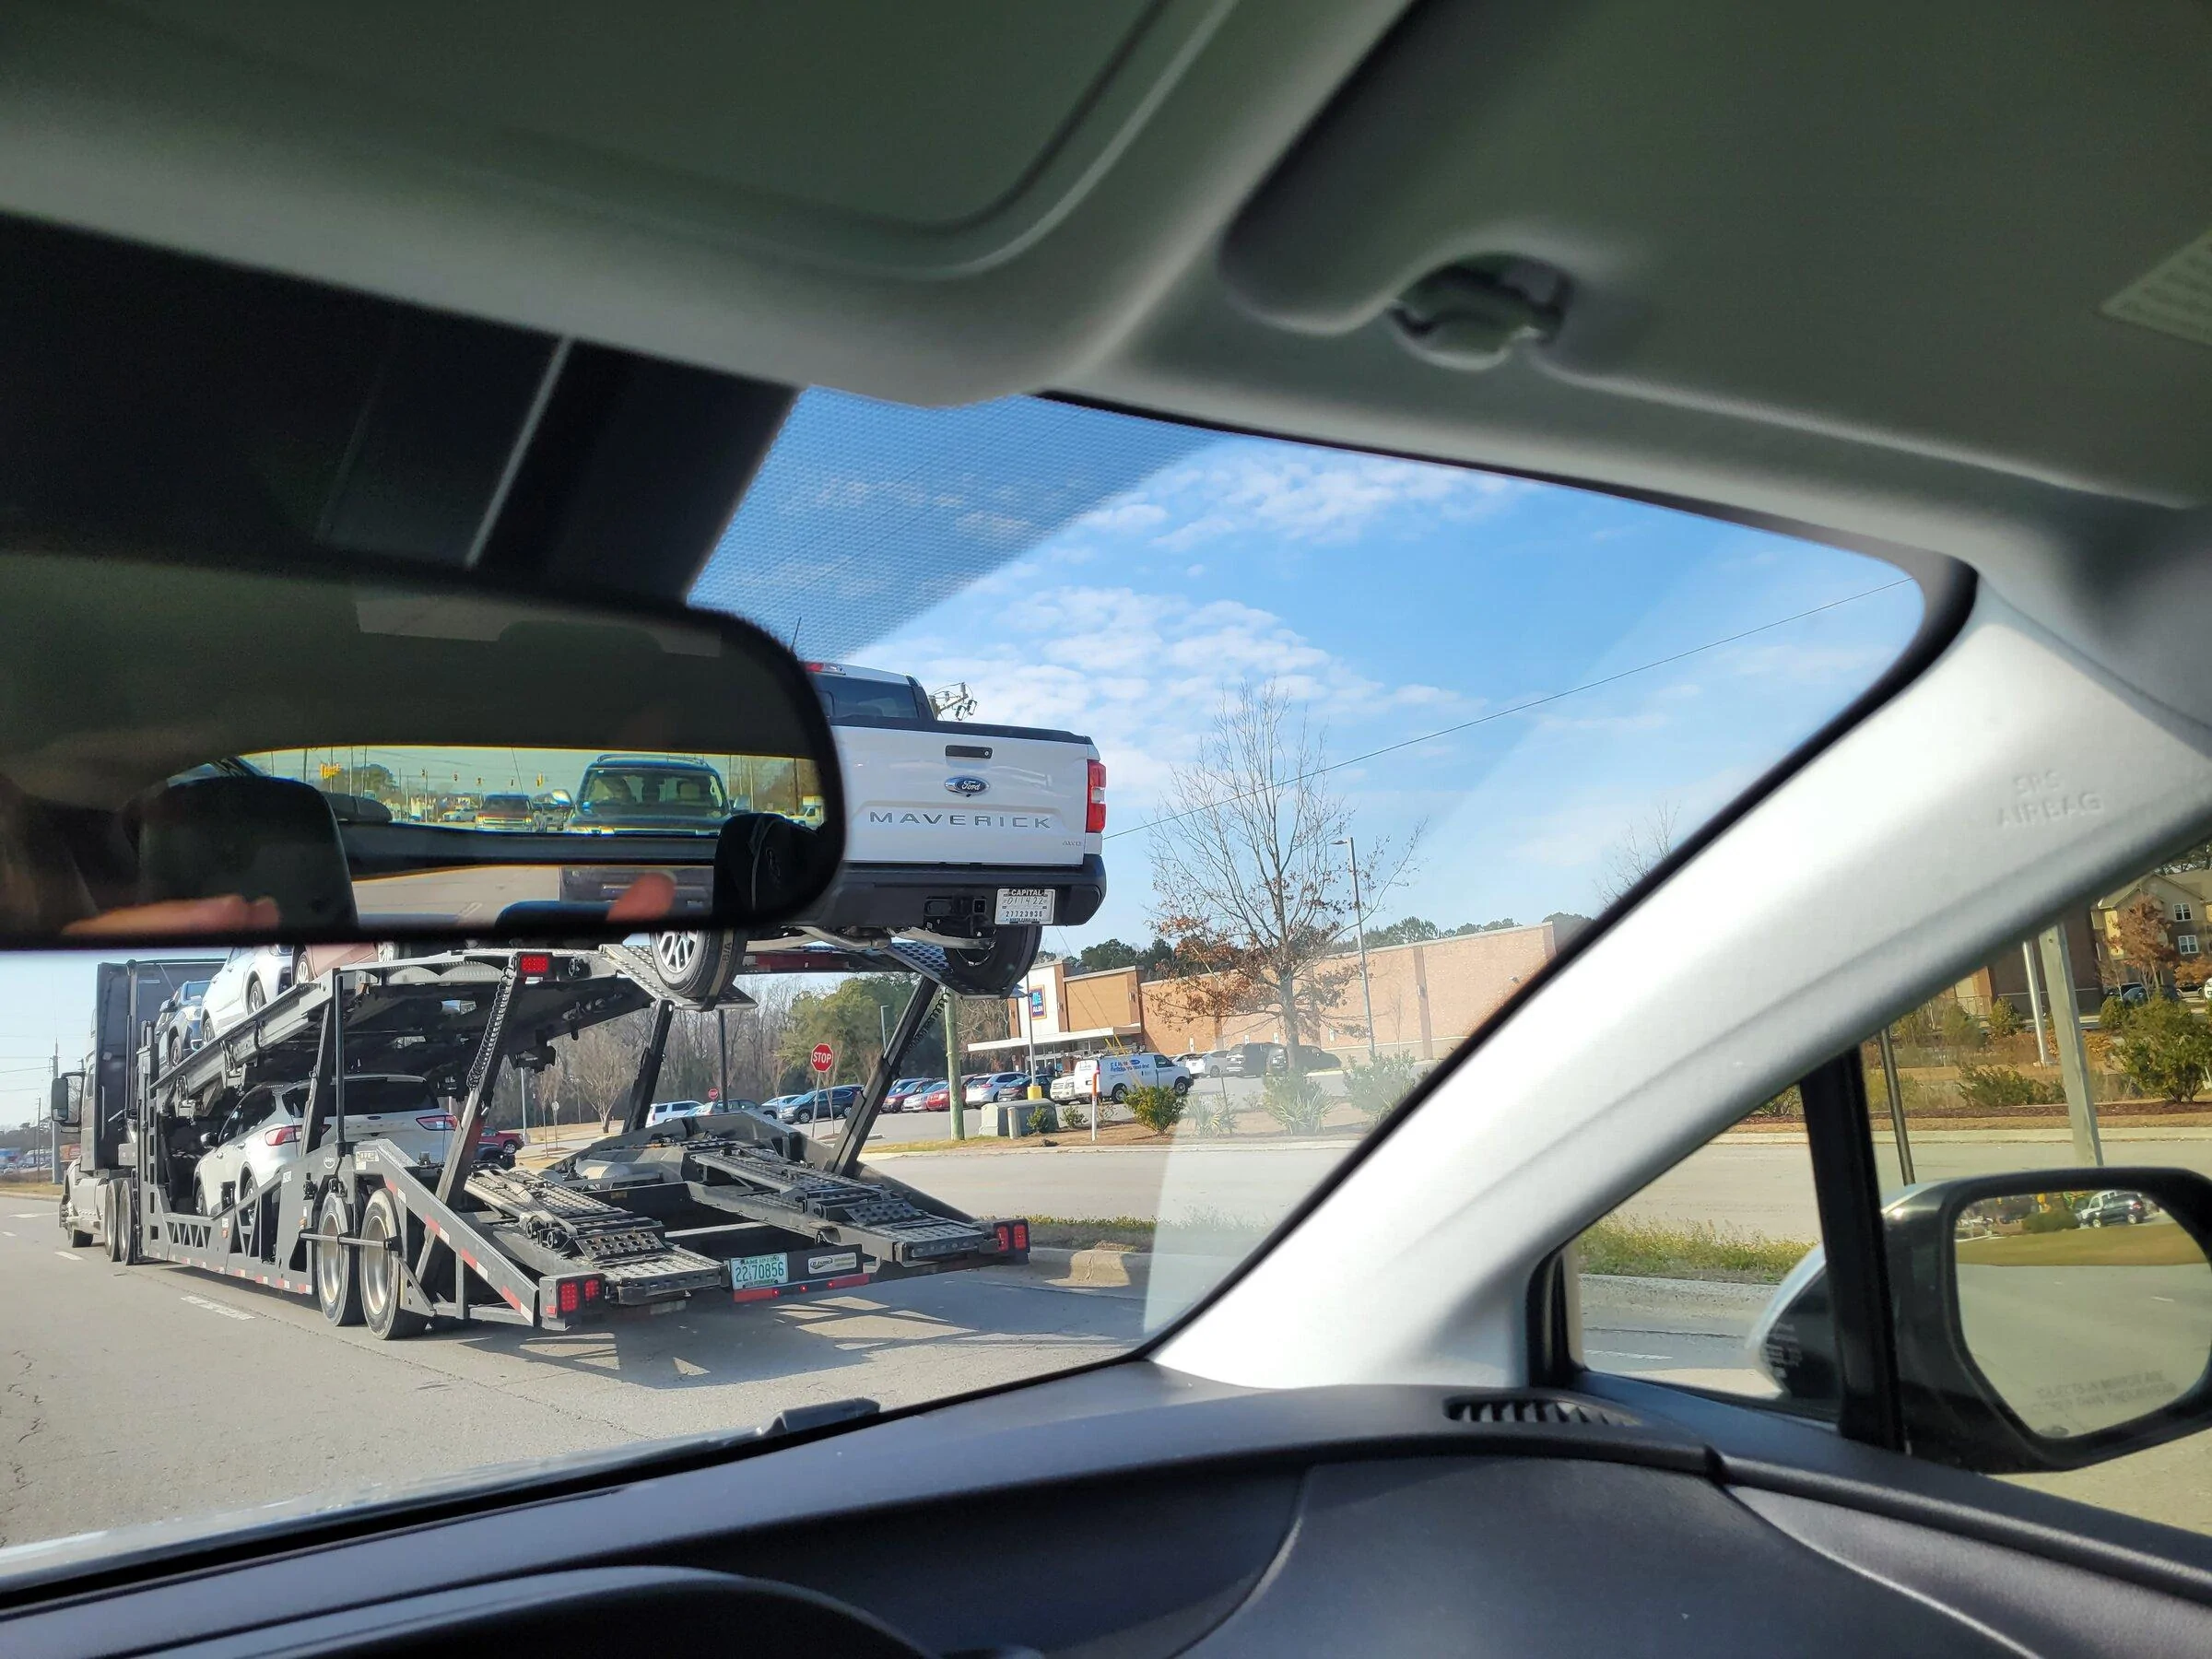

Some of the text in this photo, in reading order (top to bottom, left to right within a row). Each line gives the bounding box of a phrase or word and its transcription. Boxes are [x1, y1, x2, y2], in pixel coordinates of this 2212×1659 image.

[961, 780, 982, 791] Ford
[869, 811, 1052, 829] MAVERICK
[812, 1052, 832, 1064] STOP
